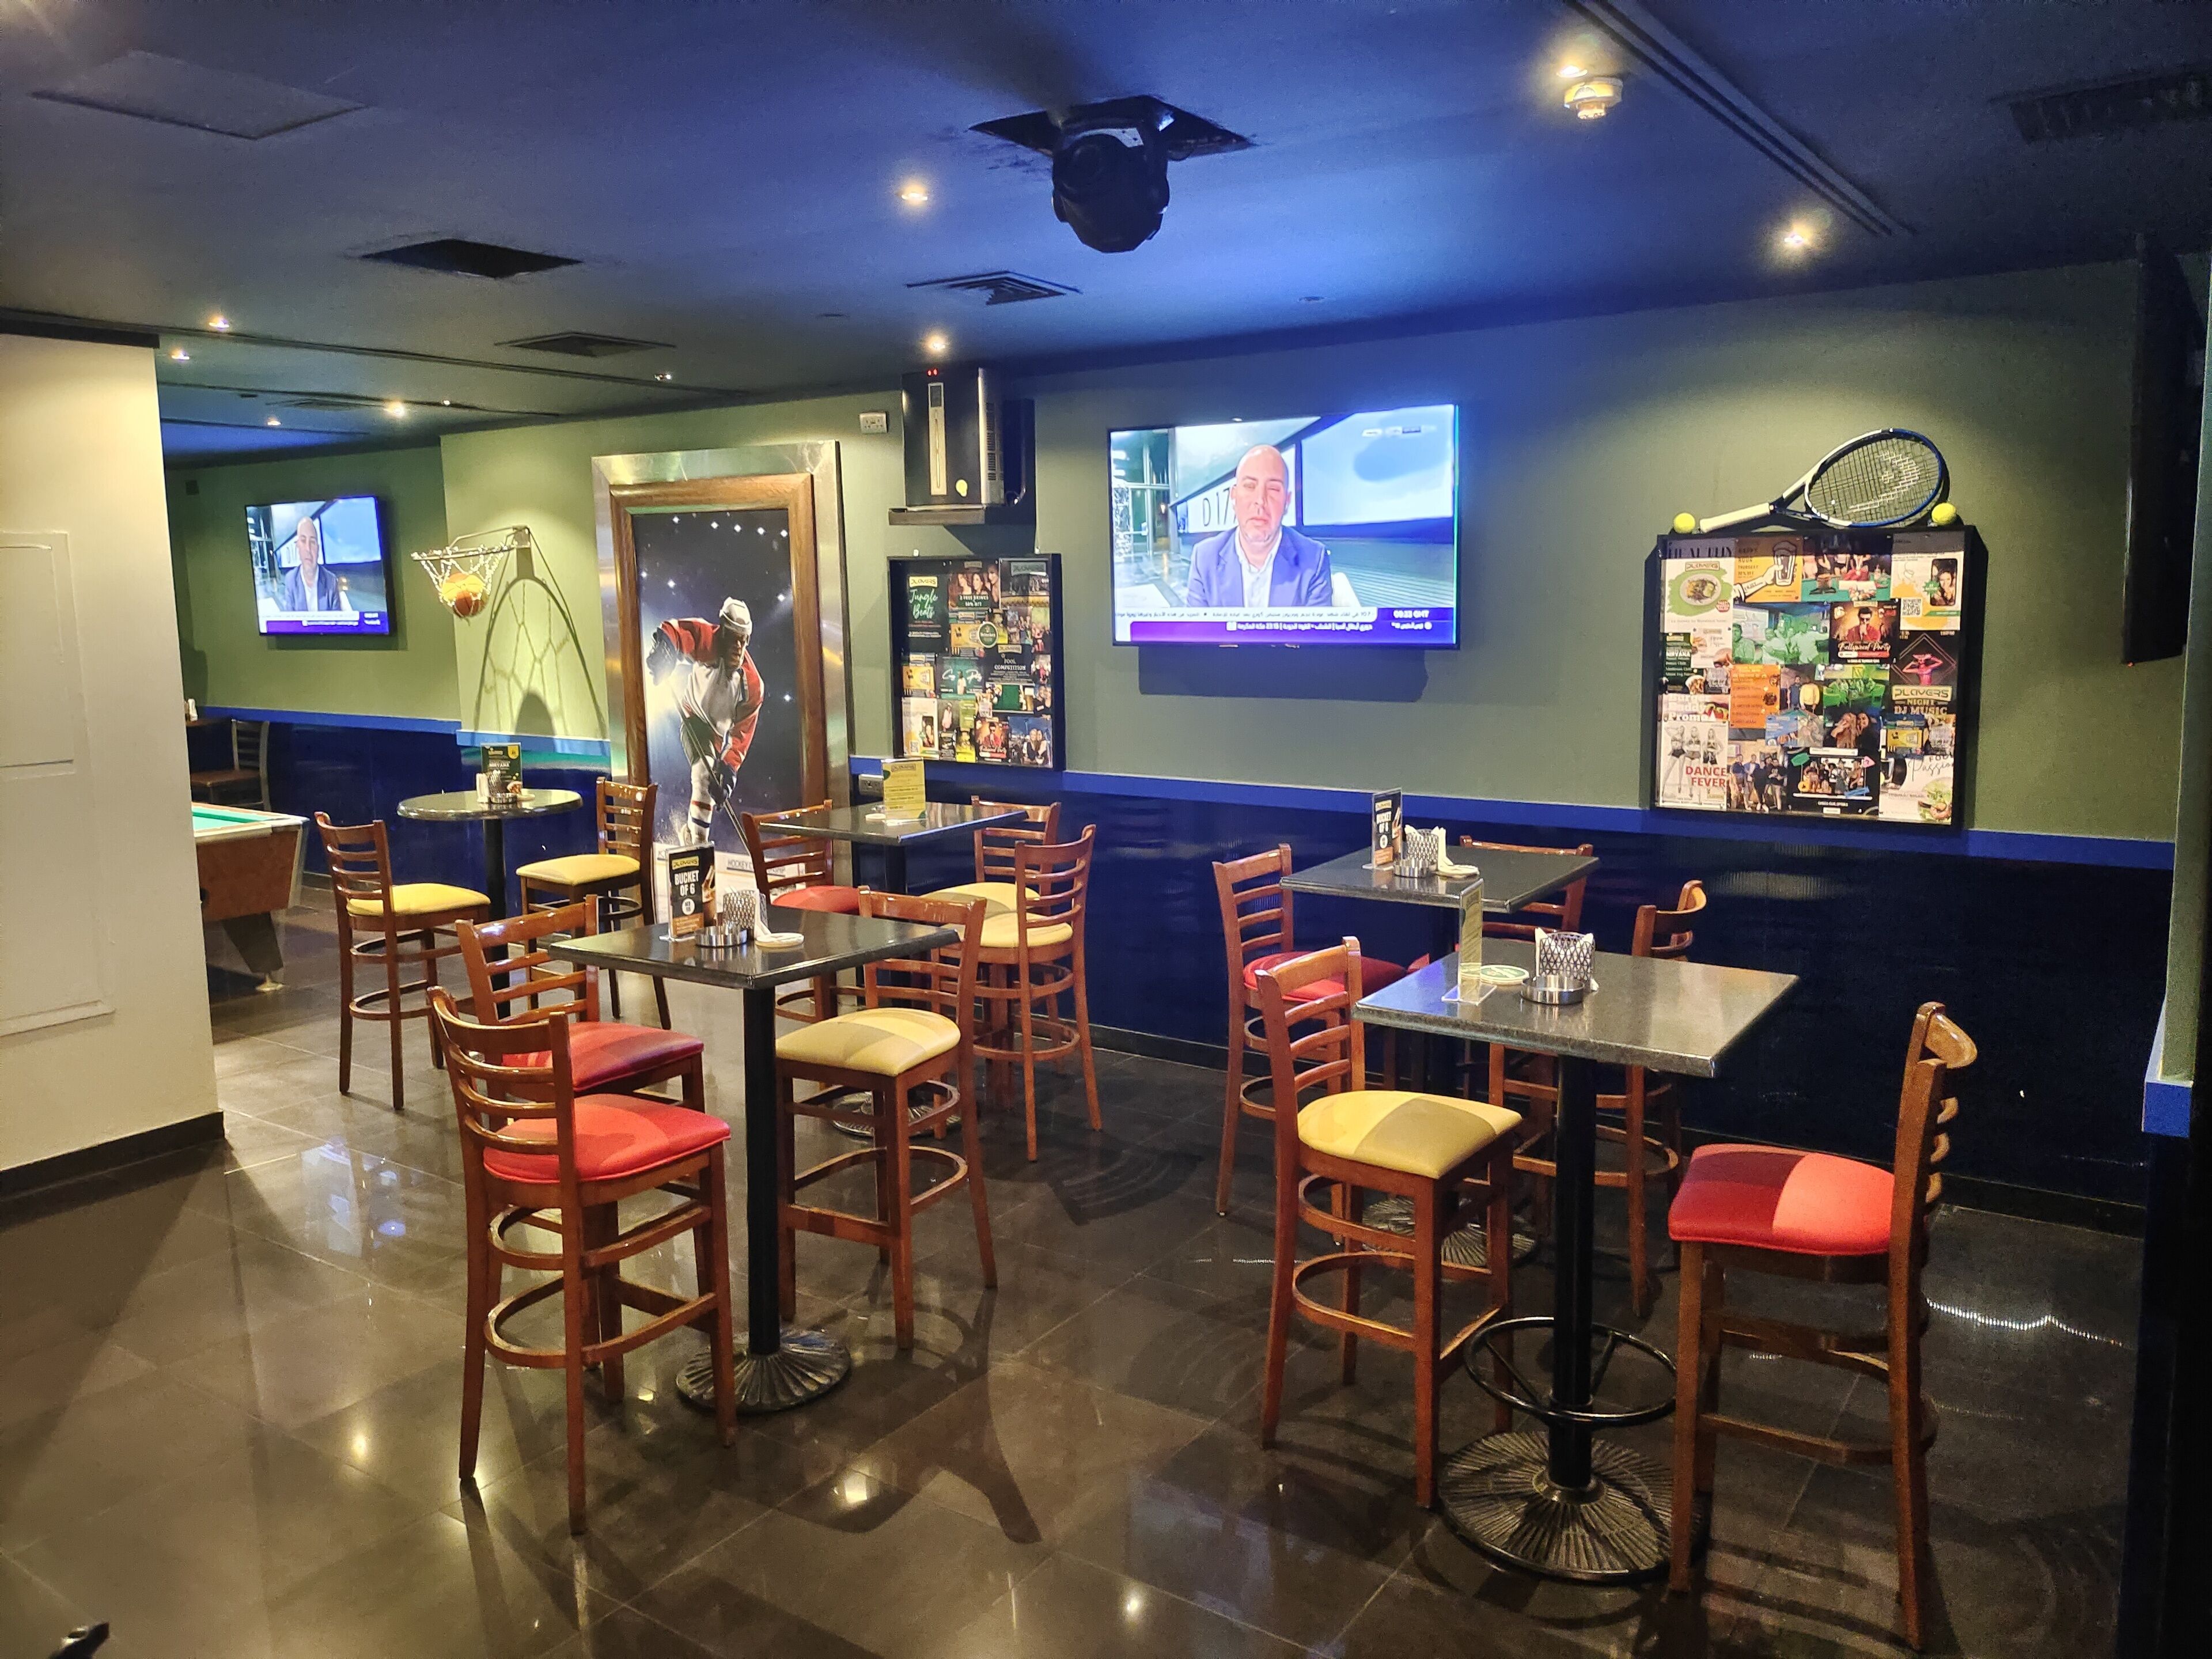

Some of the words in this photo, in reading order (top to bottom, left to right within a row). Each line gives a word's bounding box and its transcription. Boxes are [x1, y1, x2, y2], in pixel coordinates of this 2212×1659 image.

[1894, 688, 1949, 698] PLAYERS
[1894, 706, 1907, 715] DJ
[1910, 706, 1948, 715] MUSIC
[1685, 766, 1727, 777] DANCE
[1691, 777, 1726, 788] FEVER
[674, 870, 699, 885] BUCKET
[680, 884, 689, 897] OF
[690, 883, 696, 895] 6
